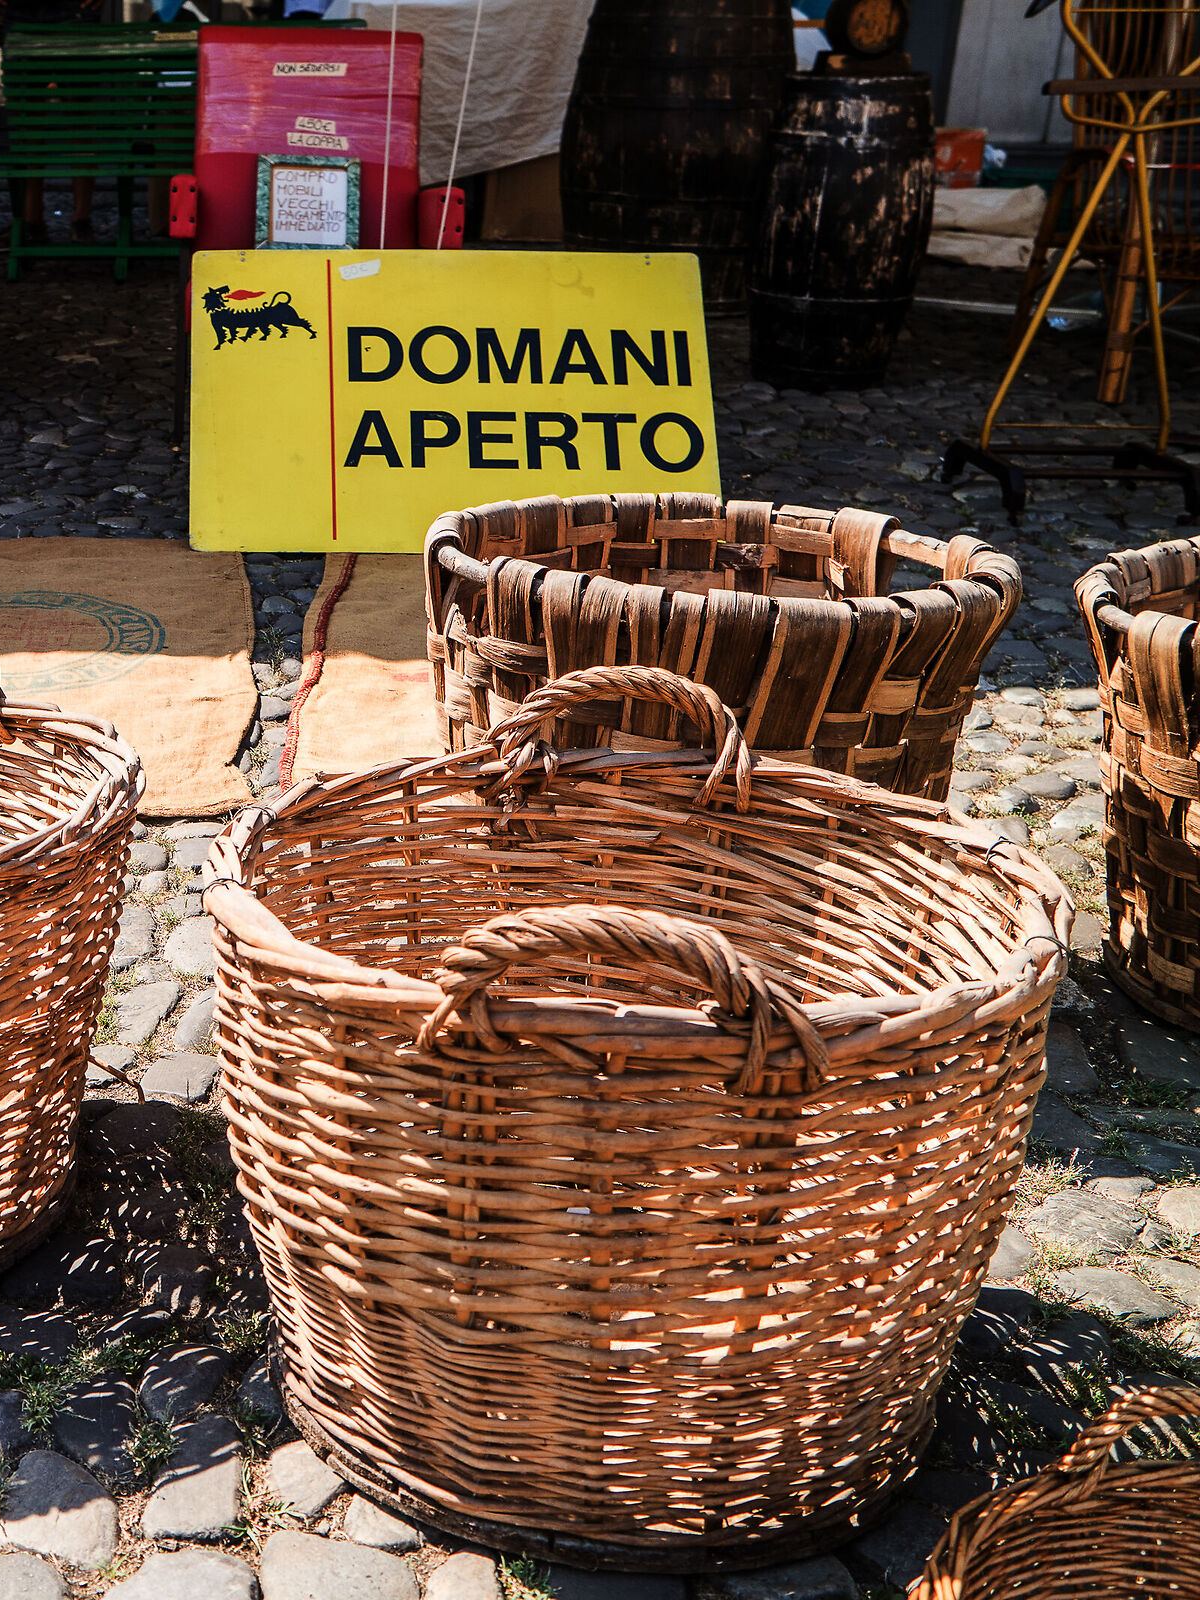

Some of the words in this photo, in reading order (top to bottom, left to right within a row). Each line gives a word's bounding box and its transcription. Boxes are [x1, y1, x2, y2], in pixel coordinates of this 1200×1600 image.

[276, 64, 296, 74] NON
[290, 133, 303, 145] LA
[275, 171, 338, 184] COMPRO
[277, 184, 323, 197] MOBILI
[277, 198, 334, 210] VECCHI
[277, 209, 347, 222] PAGAMENTO
[275, 220, 341, 232] IMMEDIATO
[346, 325, 692, 387] DOMANI
[343, 409, 705, 474] APERTO
